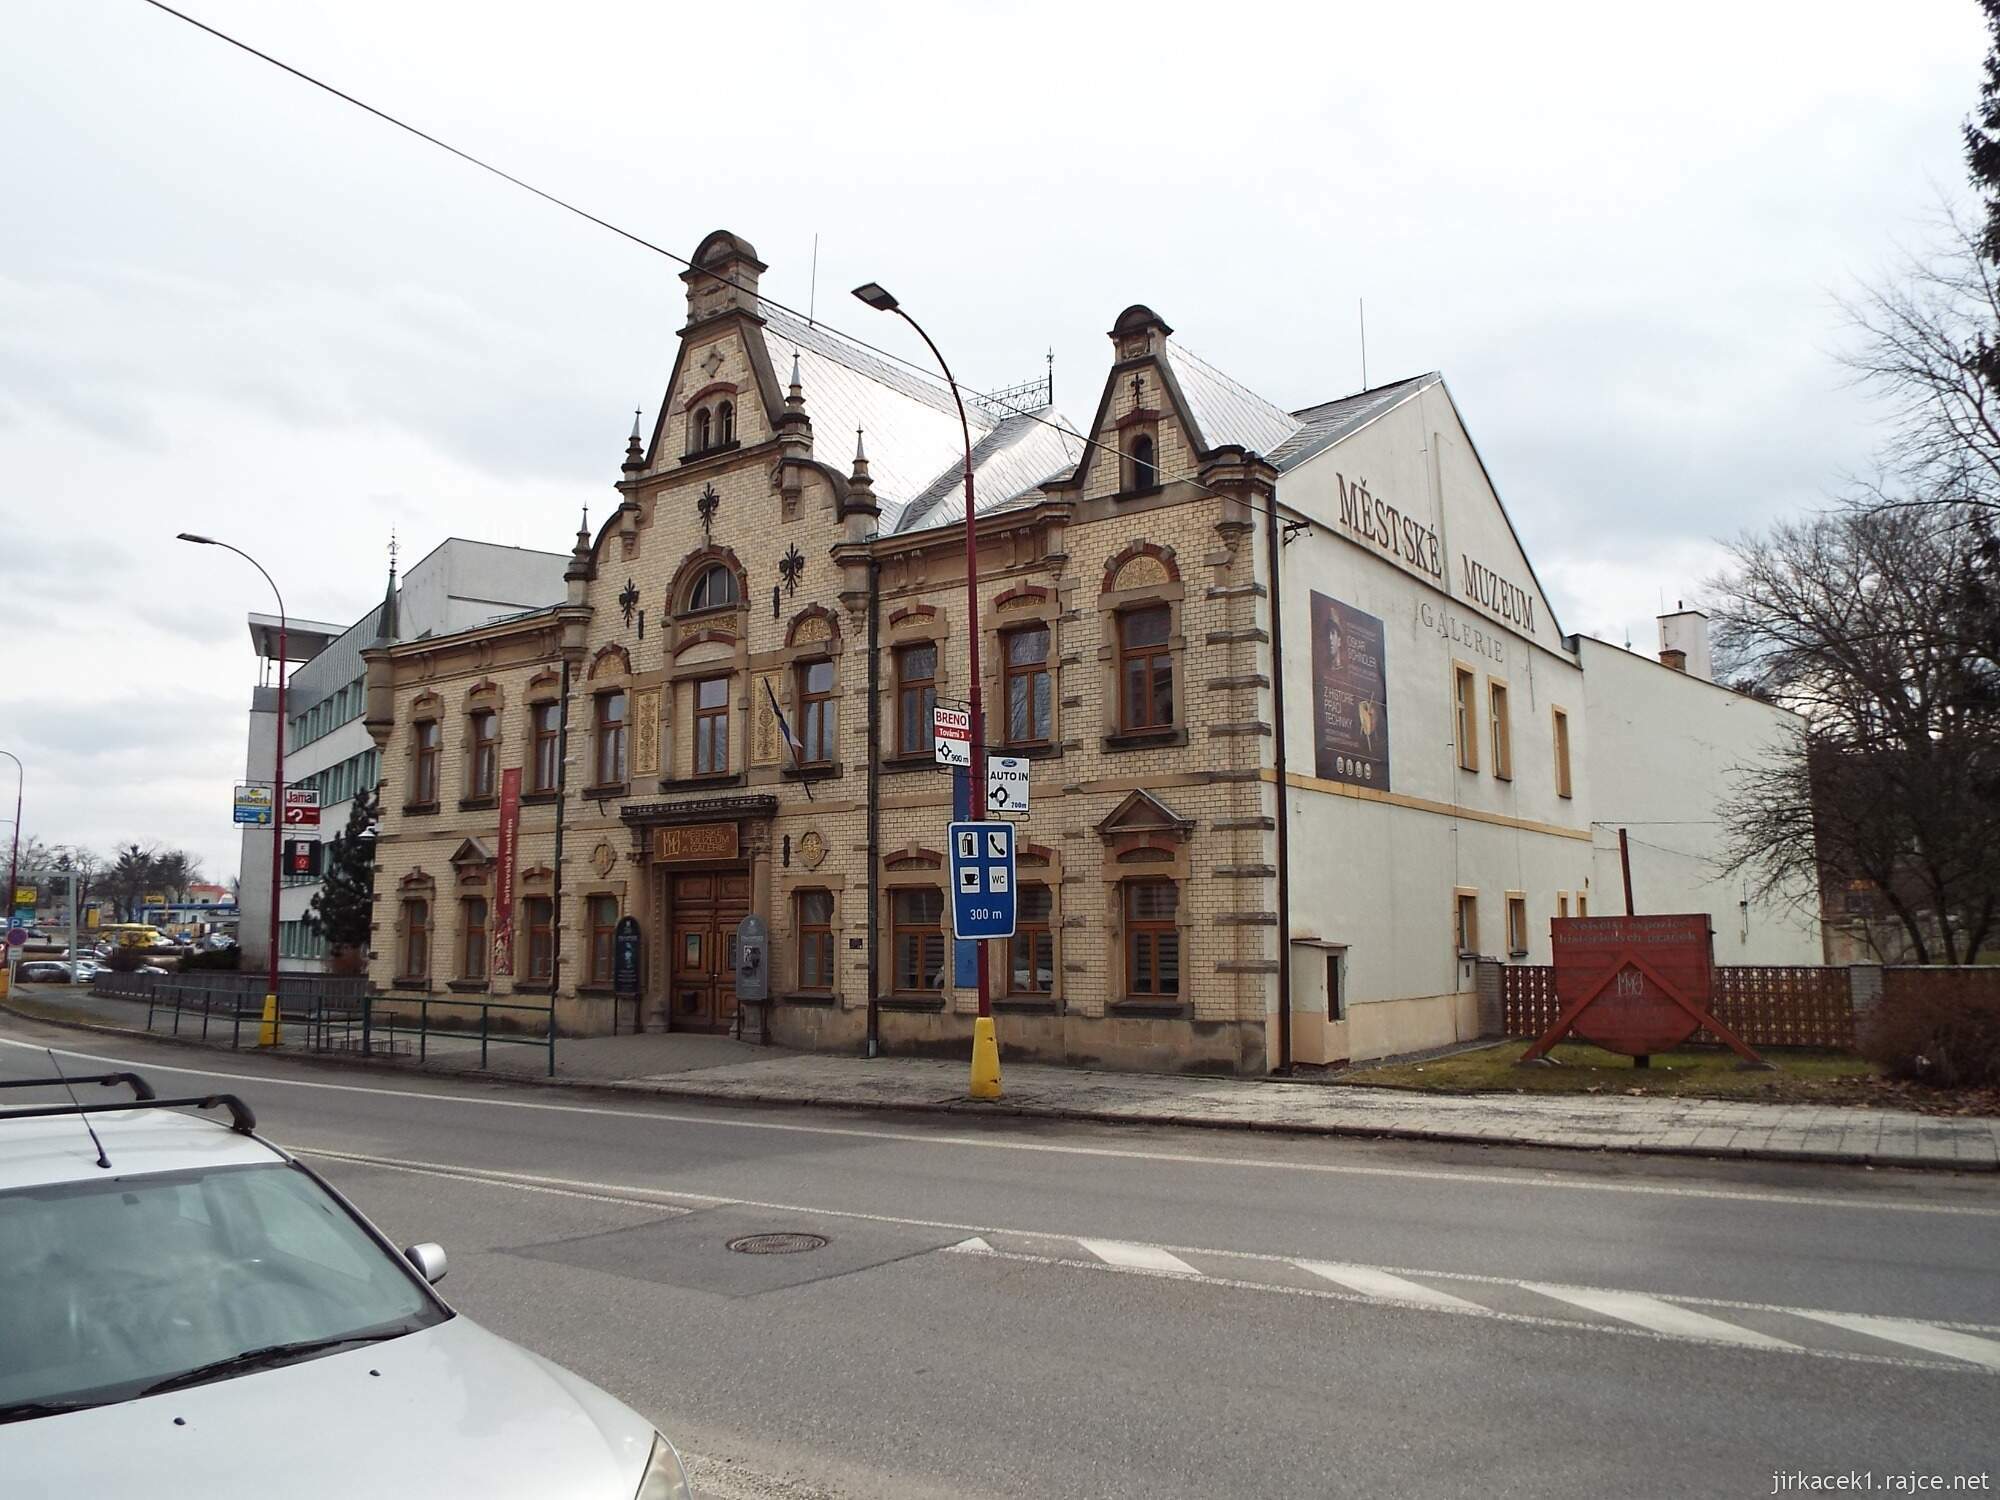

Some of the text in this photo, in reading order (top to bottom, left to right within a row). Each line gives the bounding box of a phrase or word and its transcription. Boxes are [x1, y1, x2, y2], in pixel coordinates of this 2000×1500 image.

[1336, 472, 1536, 634] MĚSTSKÉ MUZEUM
[1420, 602, 1504, 664] GALERIE
[936, 711, 967, 726] BRENO
[990, 771, 1029, 781] AUTO IN
[992, 875, 1005, 884] WC
[970, 908, 1002, 920] 300 m
